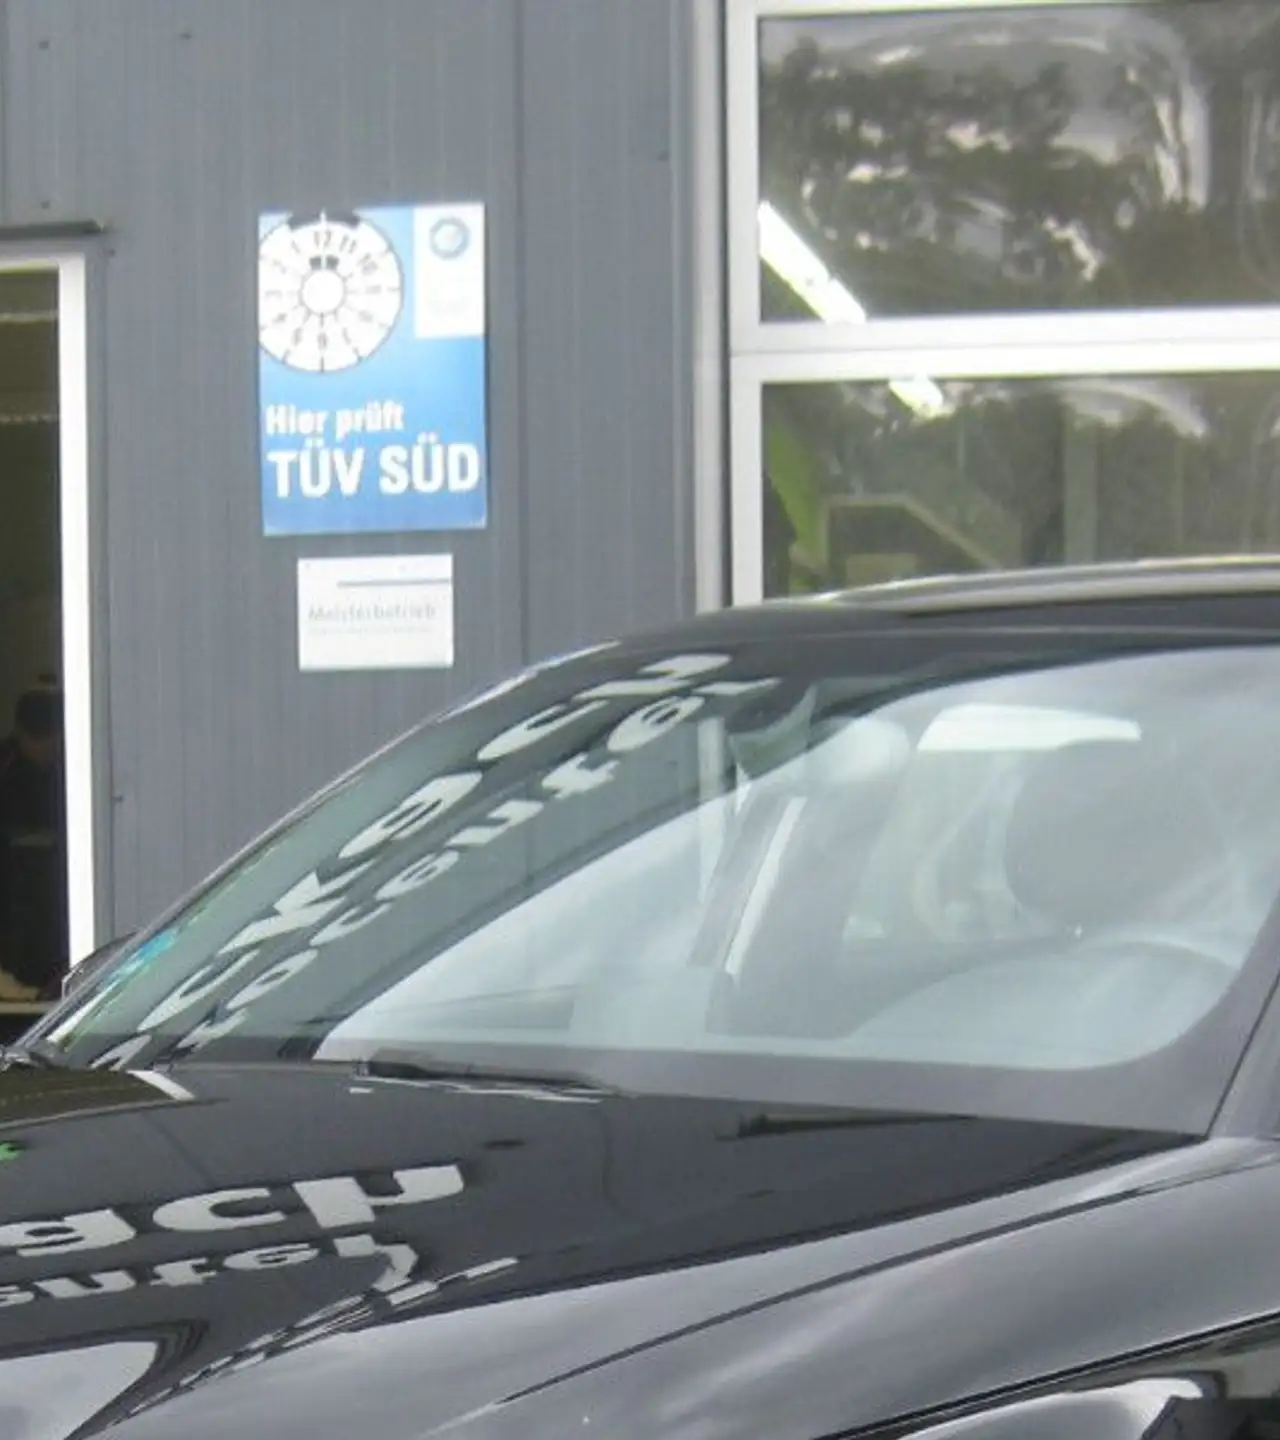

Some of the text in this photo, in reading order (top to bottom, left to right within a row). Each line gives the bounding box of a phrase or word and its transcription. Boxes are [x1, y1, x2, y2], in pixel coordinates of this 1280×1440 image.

[265, 398, 405, 442] Hier prüft
[266, 431, 480, 499] TÜV SÜD
